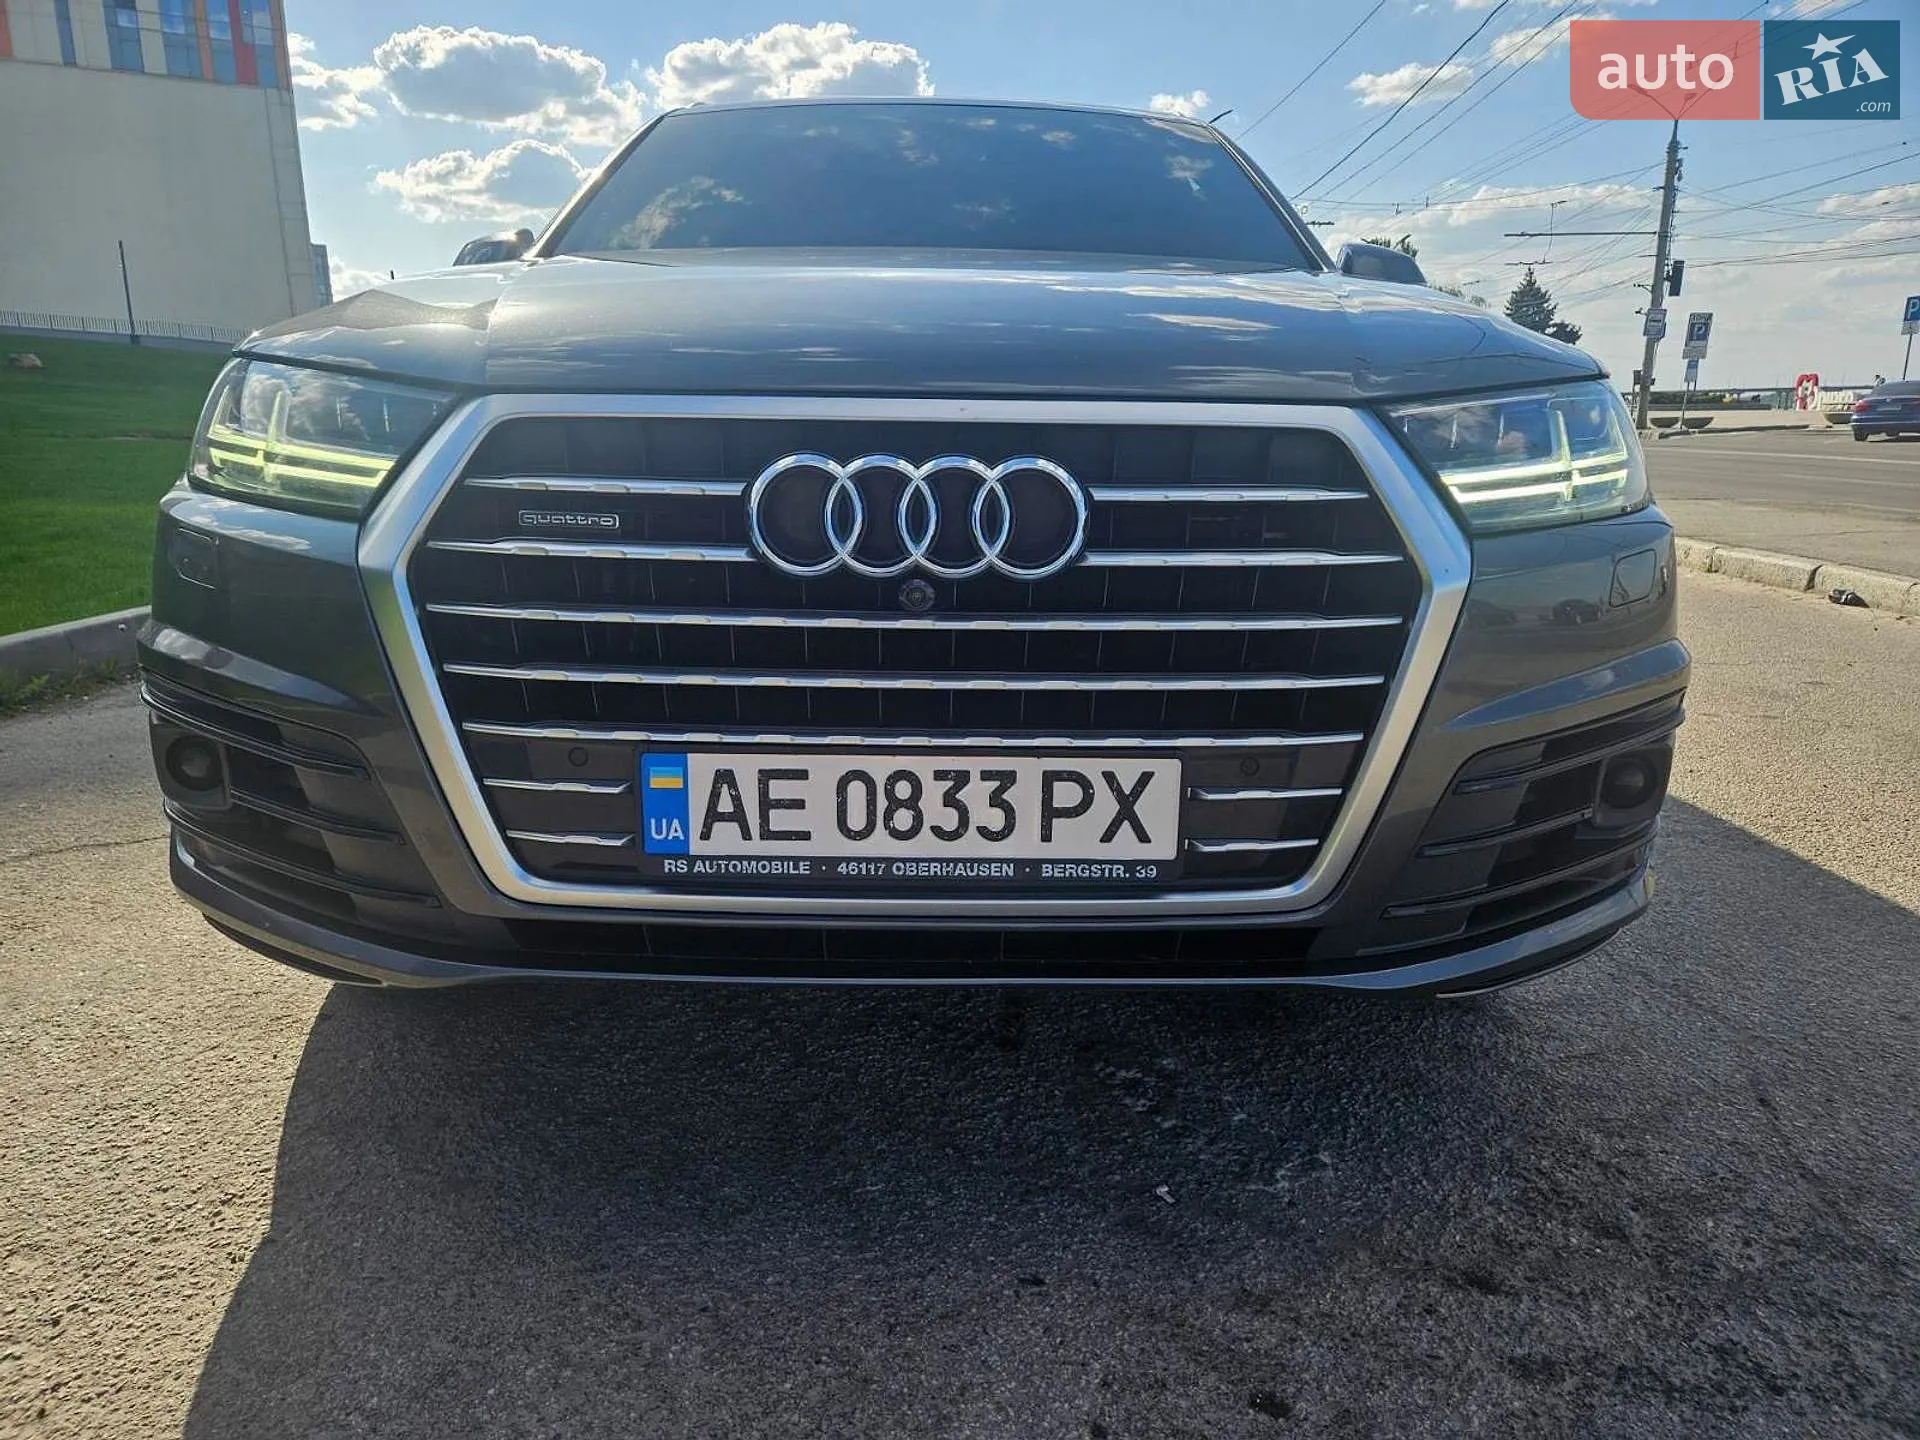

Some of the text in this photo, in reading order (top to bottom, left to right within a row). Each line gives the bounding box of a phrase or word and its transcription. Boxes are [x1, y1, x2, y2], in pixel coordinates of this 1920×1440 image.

[523, 514, 614, 526] quattro
[699, 768, 1155, 843] AE 0833 PX
[651, 818, 685, 840] UA
[664, 859, 1157, 878] RS AUTOMOBILE 46117 OBERHAUSEN BERGSTR. 39
